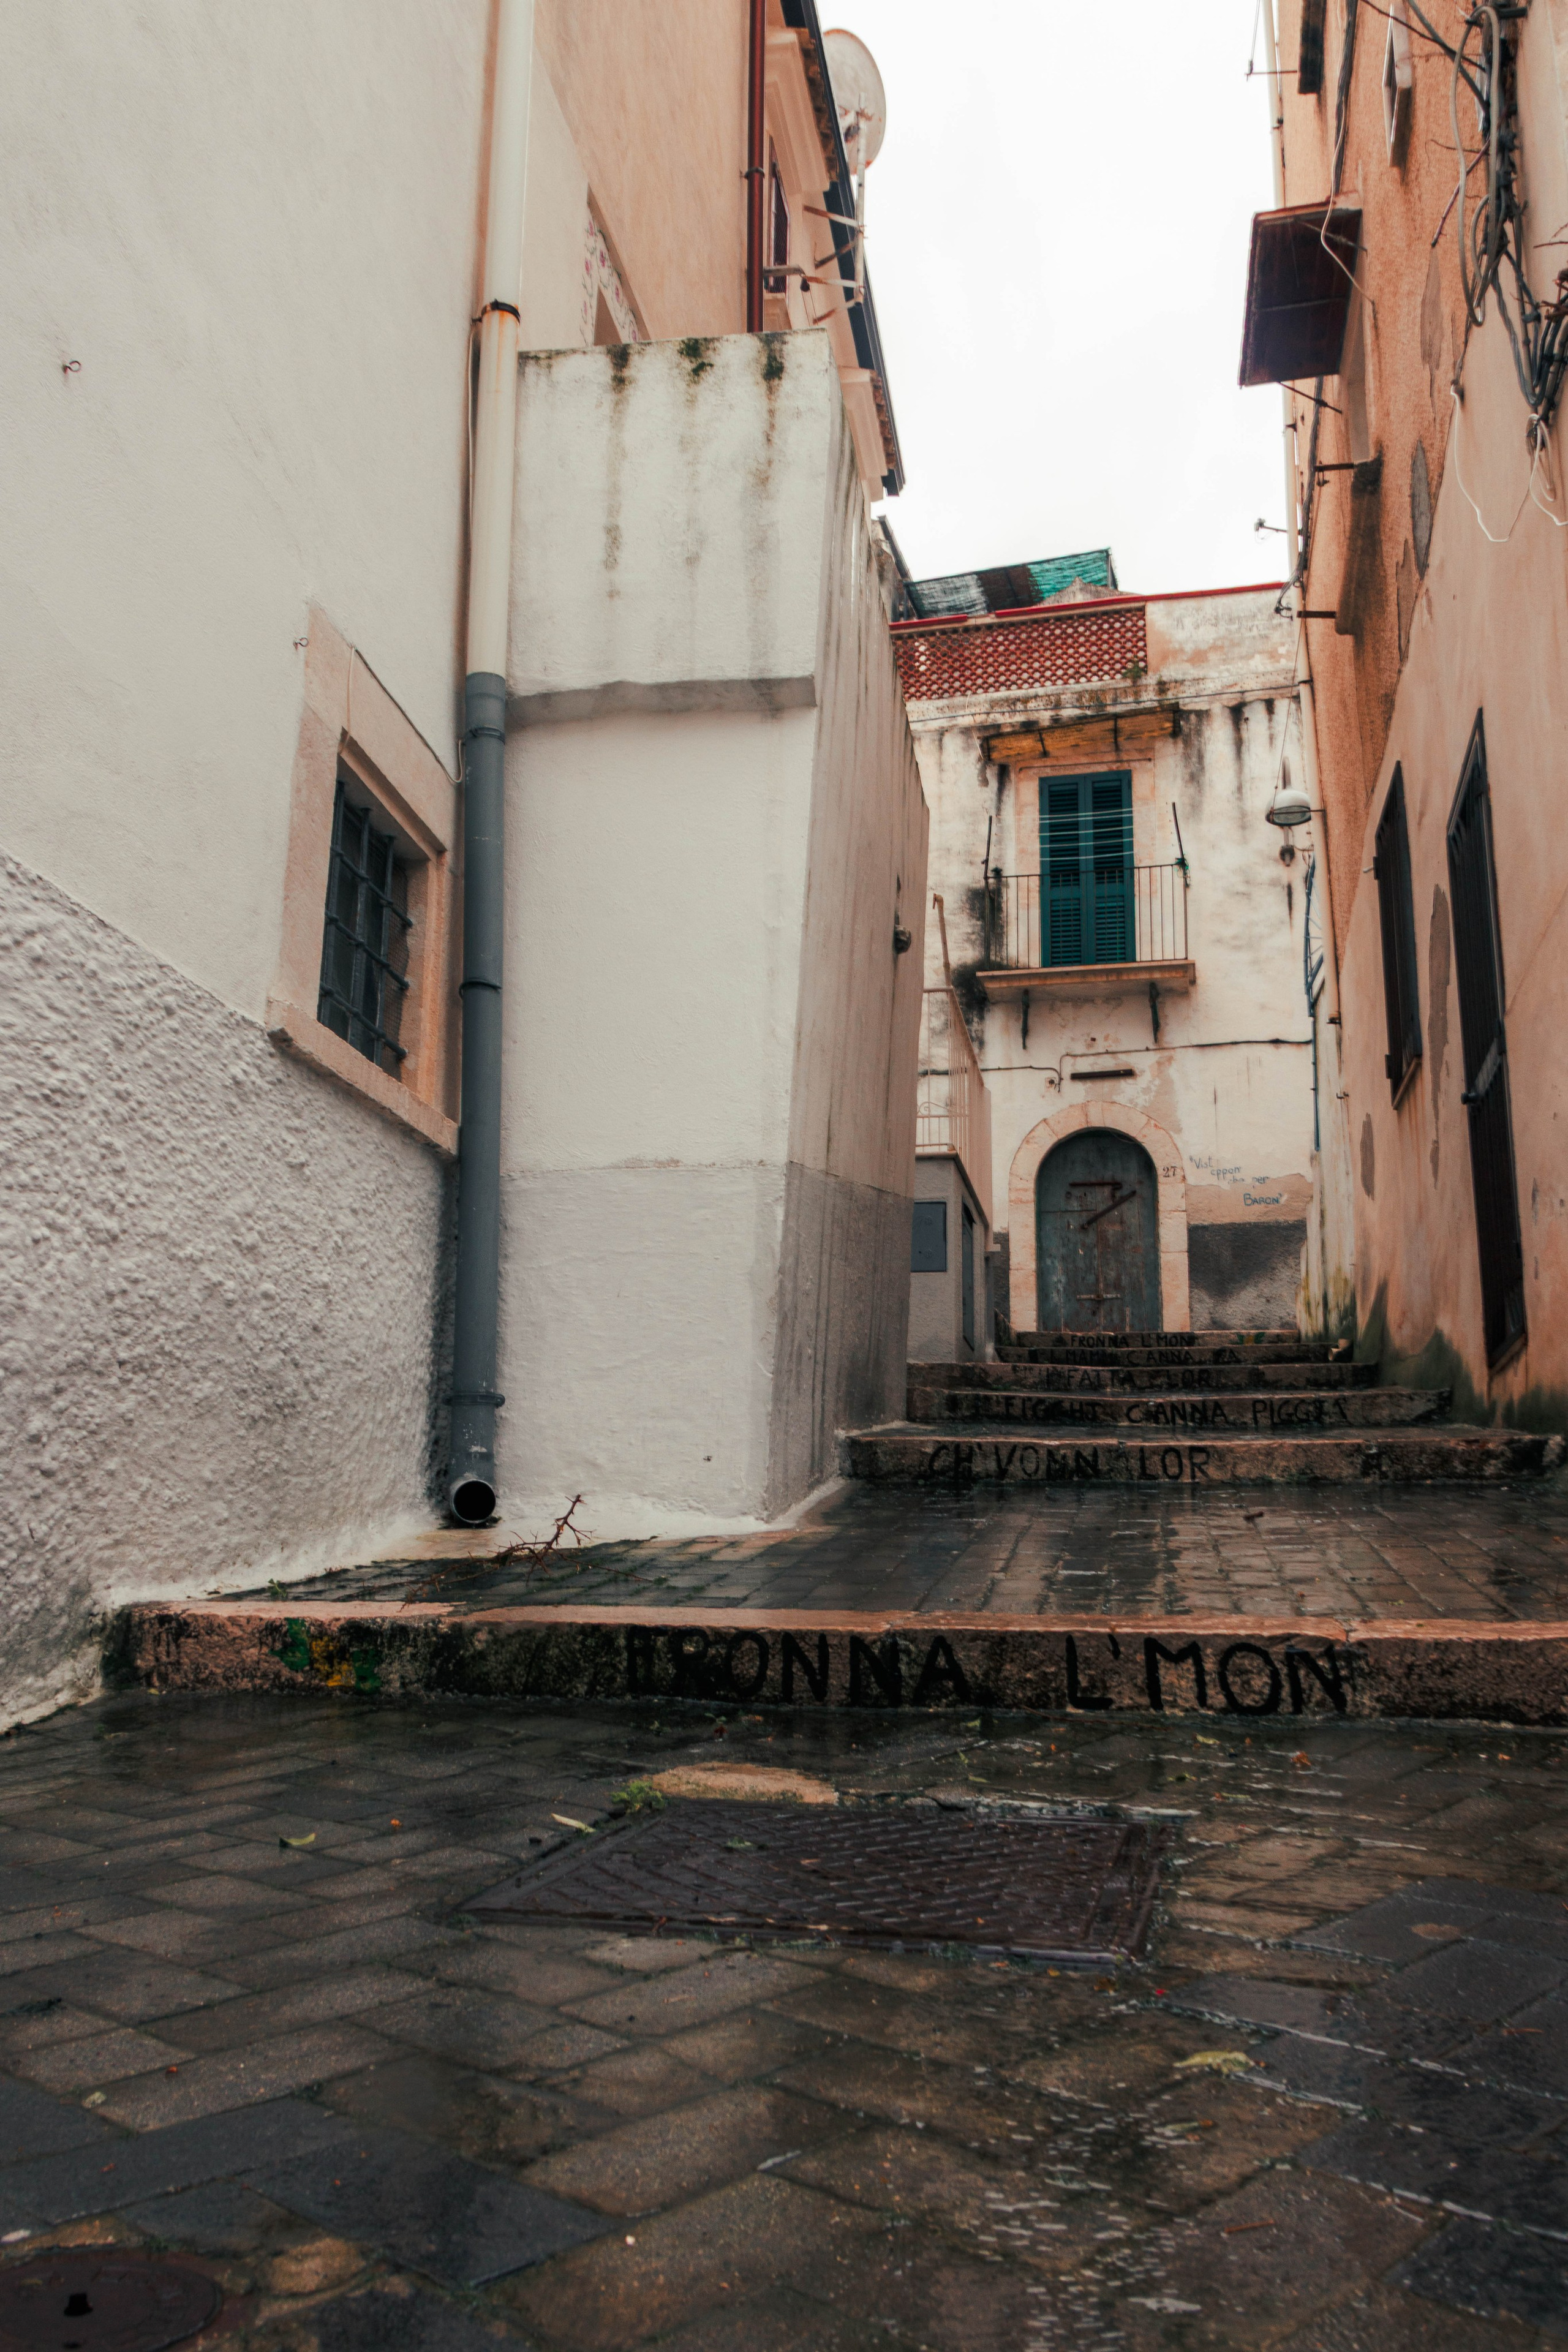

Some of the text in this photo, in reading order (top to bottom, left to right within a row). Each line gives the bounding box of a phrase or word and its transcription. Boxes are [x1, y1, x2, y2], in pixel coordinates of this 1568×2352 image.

[1163, 1166, 1177, 1177] 27
[1071, 1335, 1129, 1348] FRONNA
[1067, 1368, 1137, 1388] FATTA
[1139, 1447, 1212, 1482] LOR
[1066, 1634, 1348, 1716] L'MON
